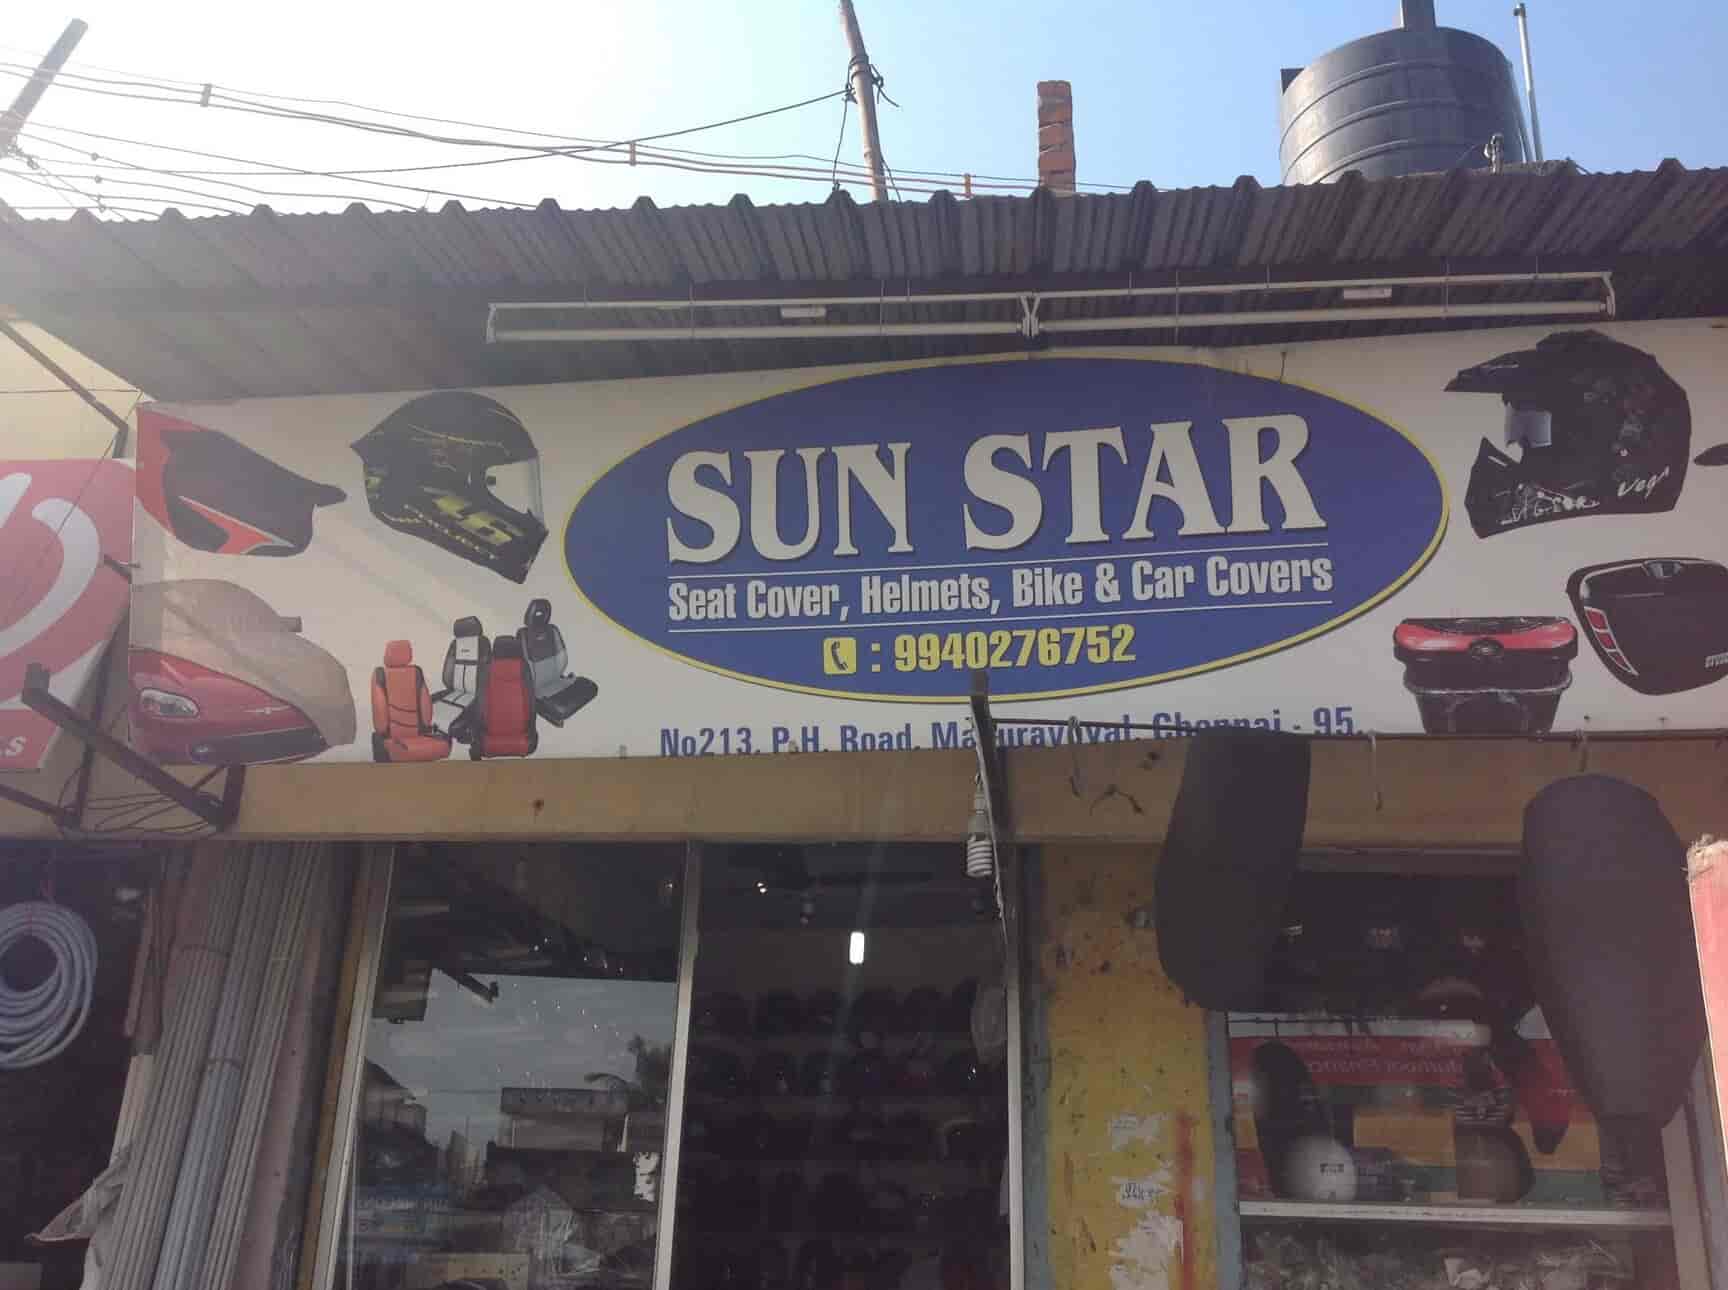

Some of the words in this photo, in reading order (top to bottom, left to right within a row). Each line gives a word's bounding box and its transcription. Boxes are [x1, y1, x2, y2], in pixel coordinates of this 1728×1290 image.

[667, 442, 914, 564] SUN
[963, 413, 1327, 550] STAR
[668, 583, 736, 620] Seat
[747, 579, 850, 621] Cover,
[861, 573, 1000, 615] Helmets,
[1011, 567, 1083, 608] Bike
[1095, 562, 1121, 603] &
[1131, 559, 1195, 601] Car
[1206, 555, 1334, 597] Covers
[894, 623, 1137, 672] 9940276752
